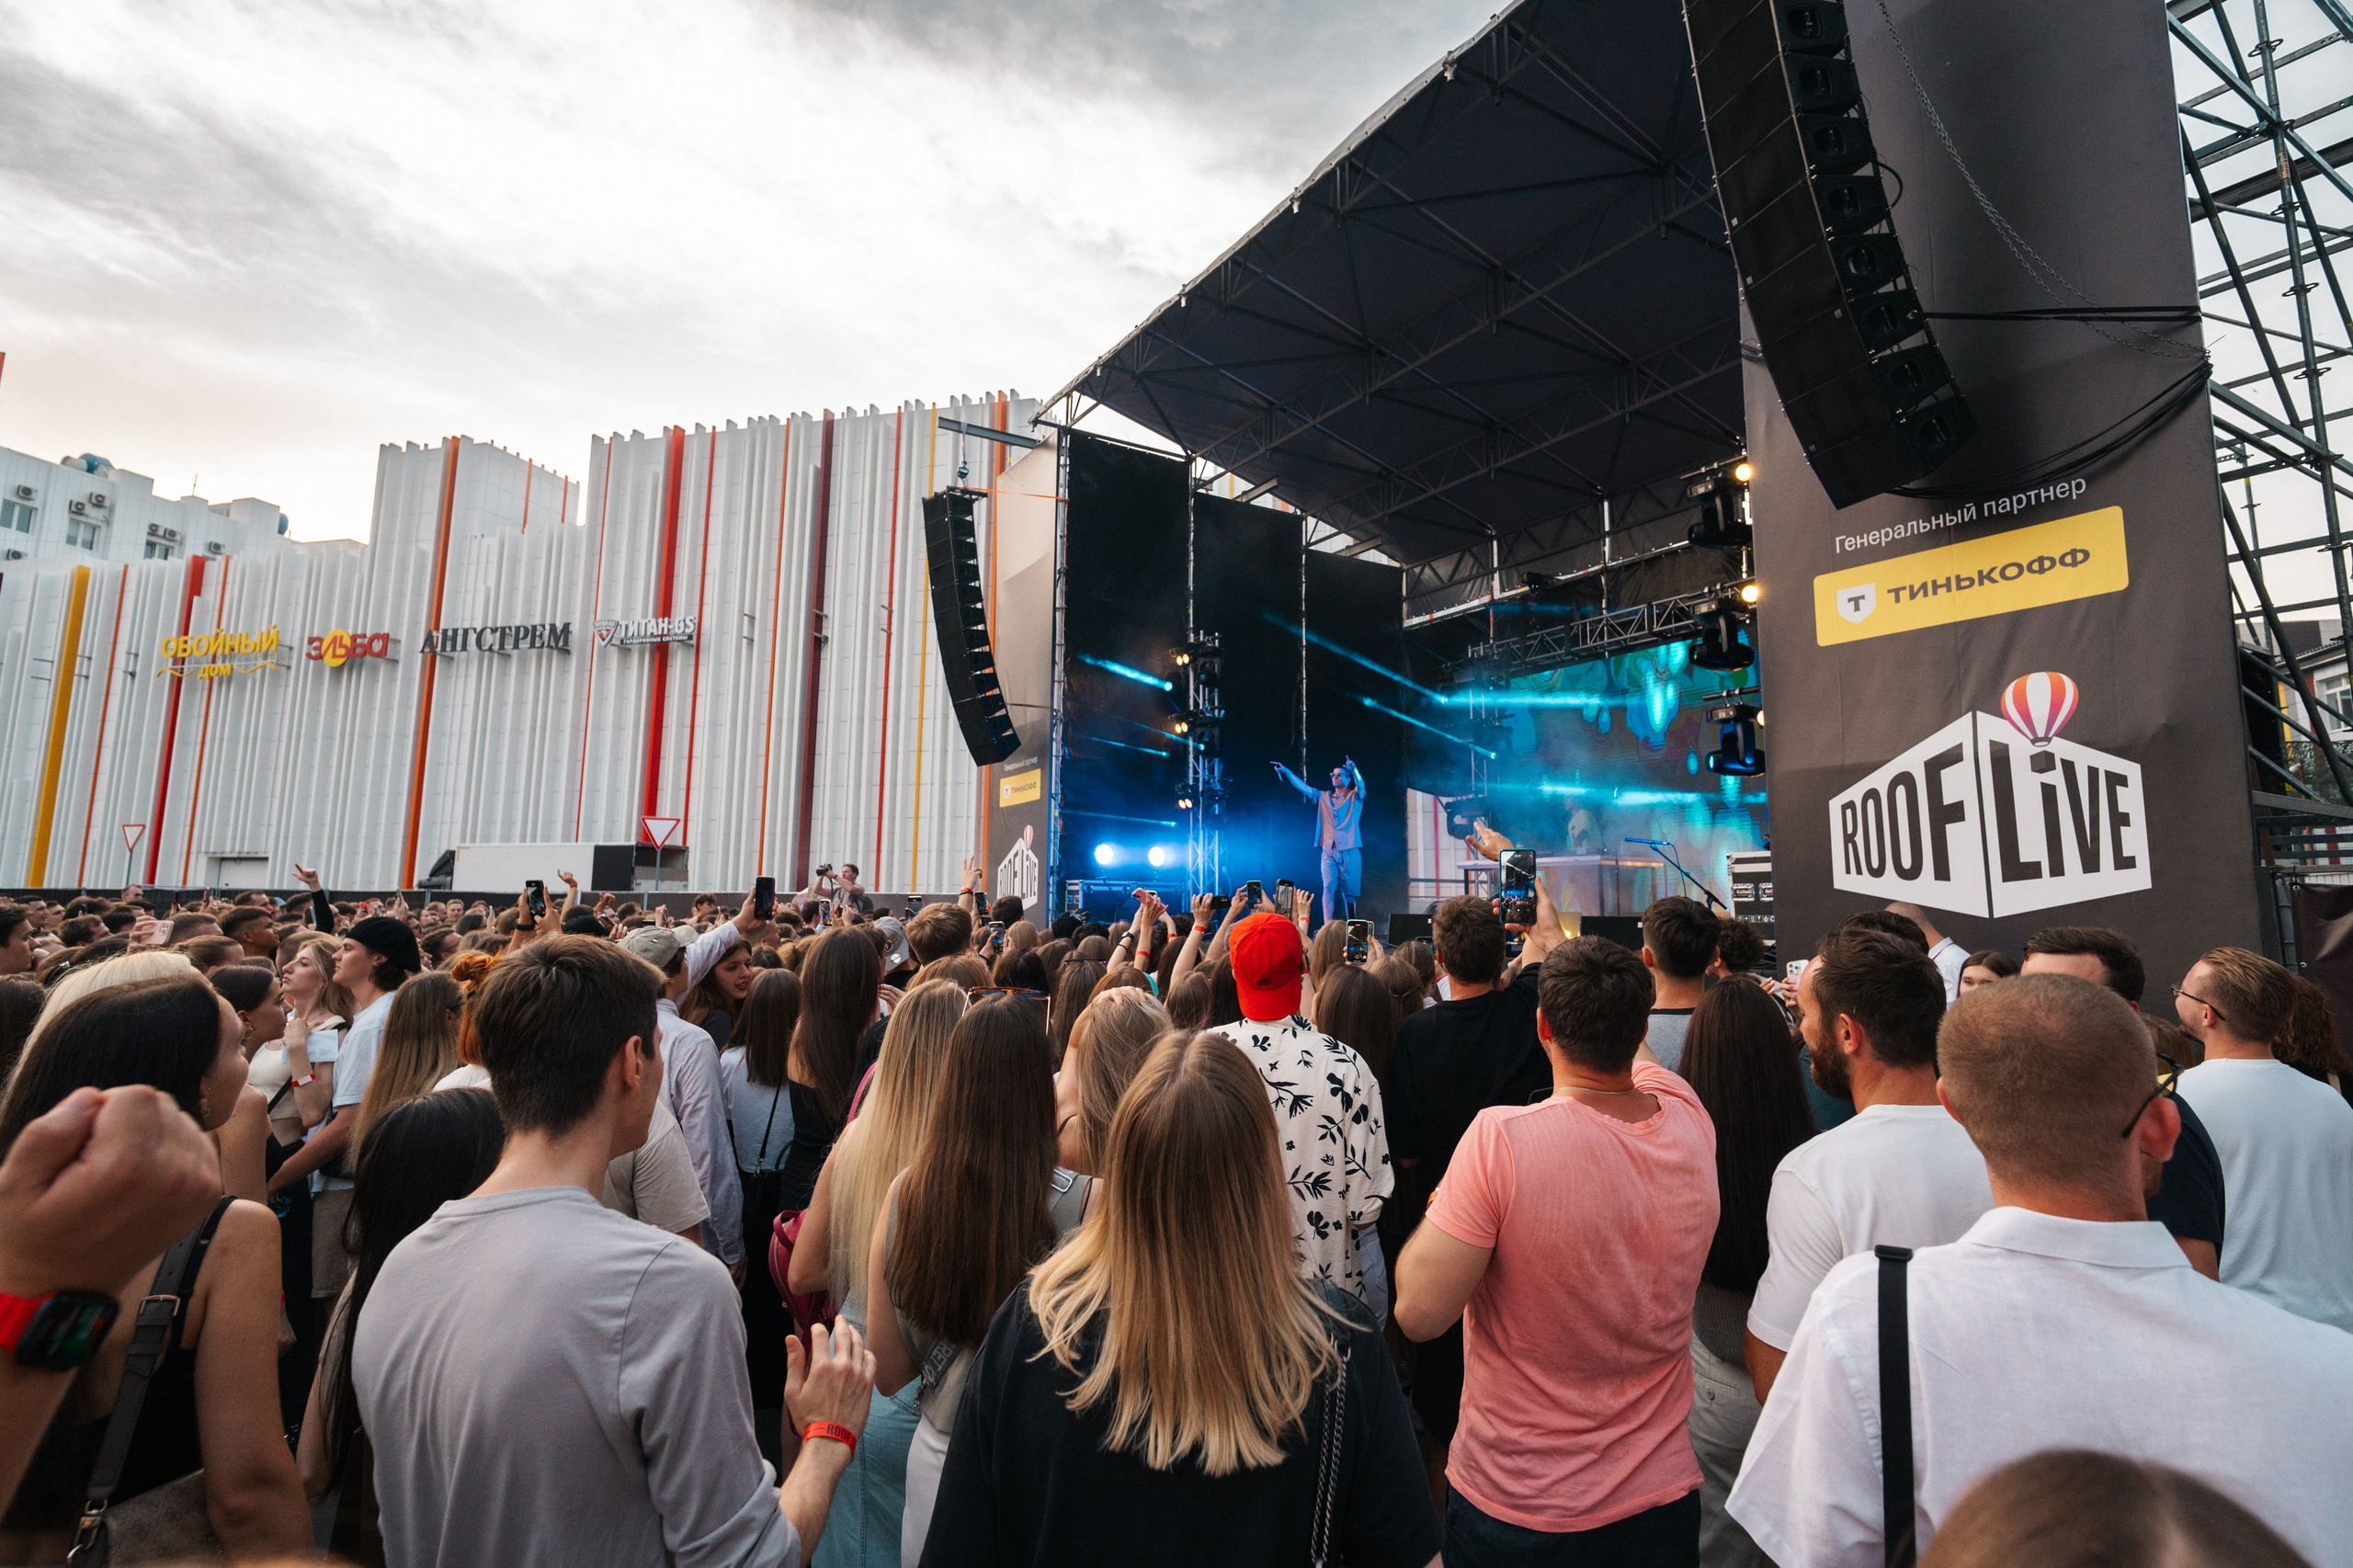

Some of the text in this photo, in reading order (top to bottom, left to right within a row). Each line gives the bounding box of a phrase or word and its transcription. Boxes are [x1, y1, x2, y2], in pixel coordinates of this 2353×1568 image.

[1836, 478, 2086, 553] Генеральный партнер
[1887, 548, 2090, 604] ТИНЬКОФФ
[161, 624, 279, 658] ОБОЙНЫЙ
[419, 622, 572, 654] АНГСТРЕМ
[620, 615, 696, 638] ТИТАН-GS
[1841, 742, 1966, 882] ROOF
[826, 1424, 851, 1442] ROOF
